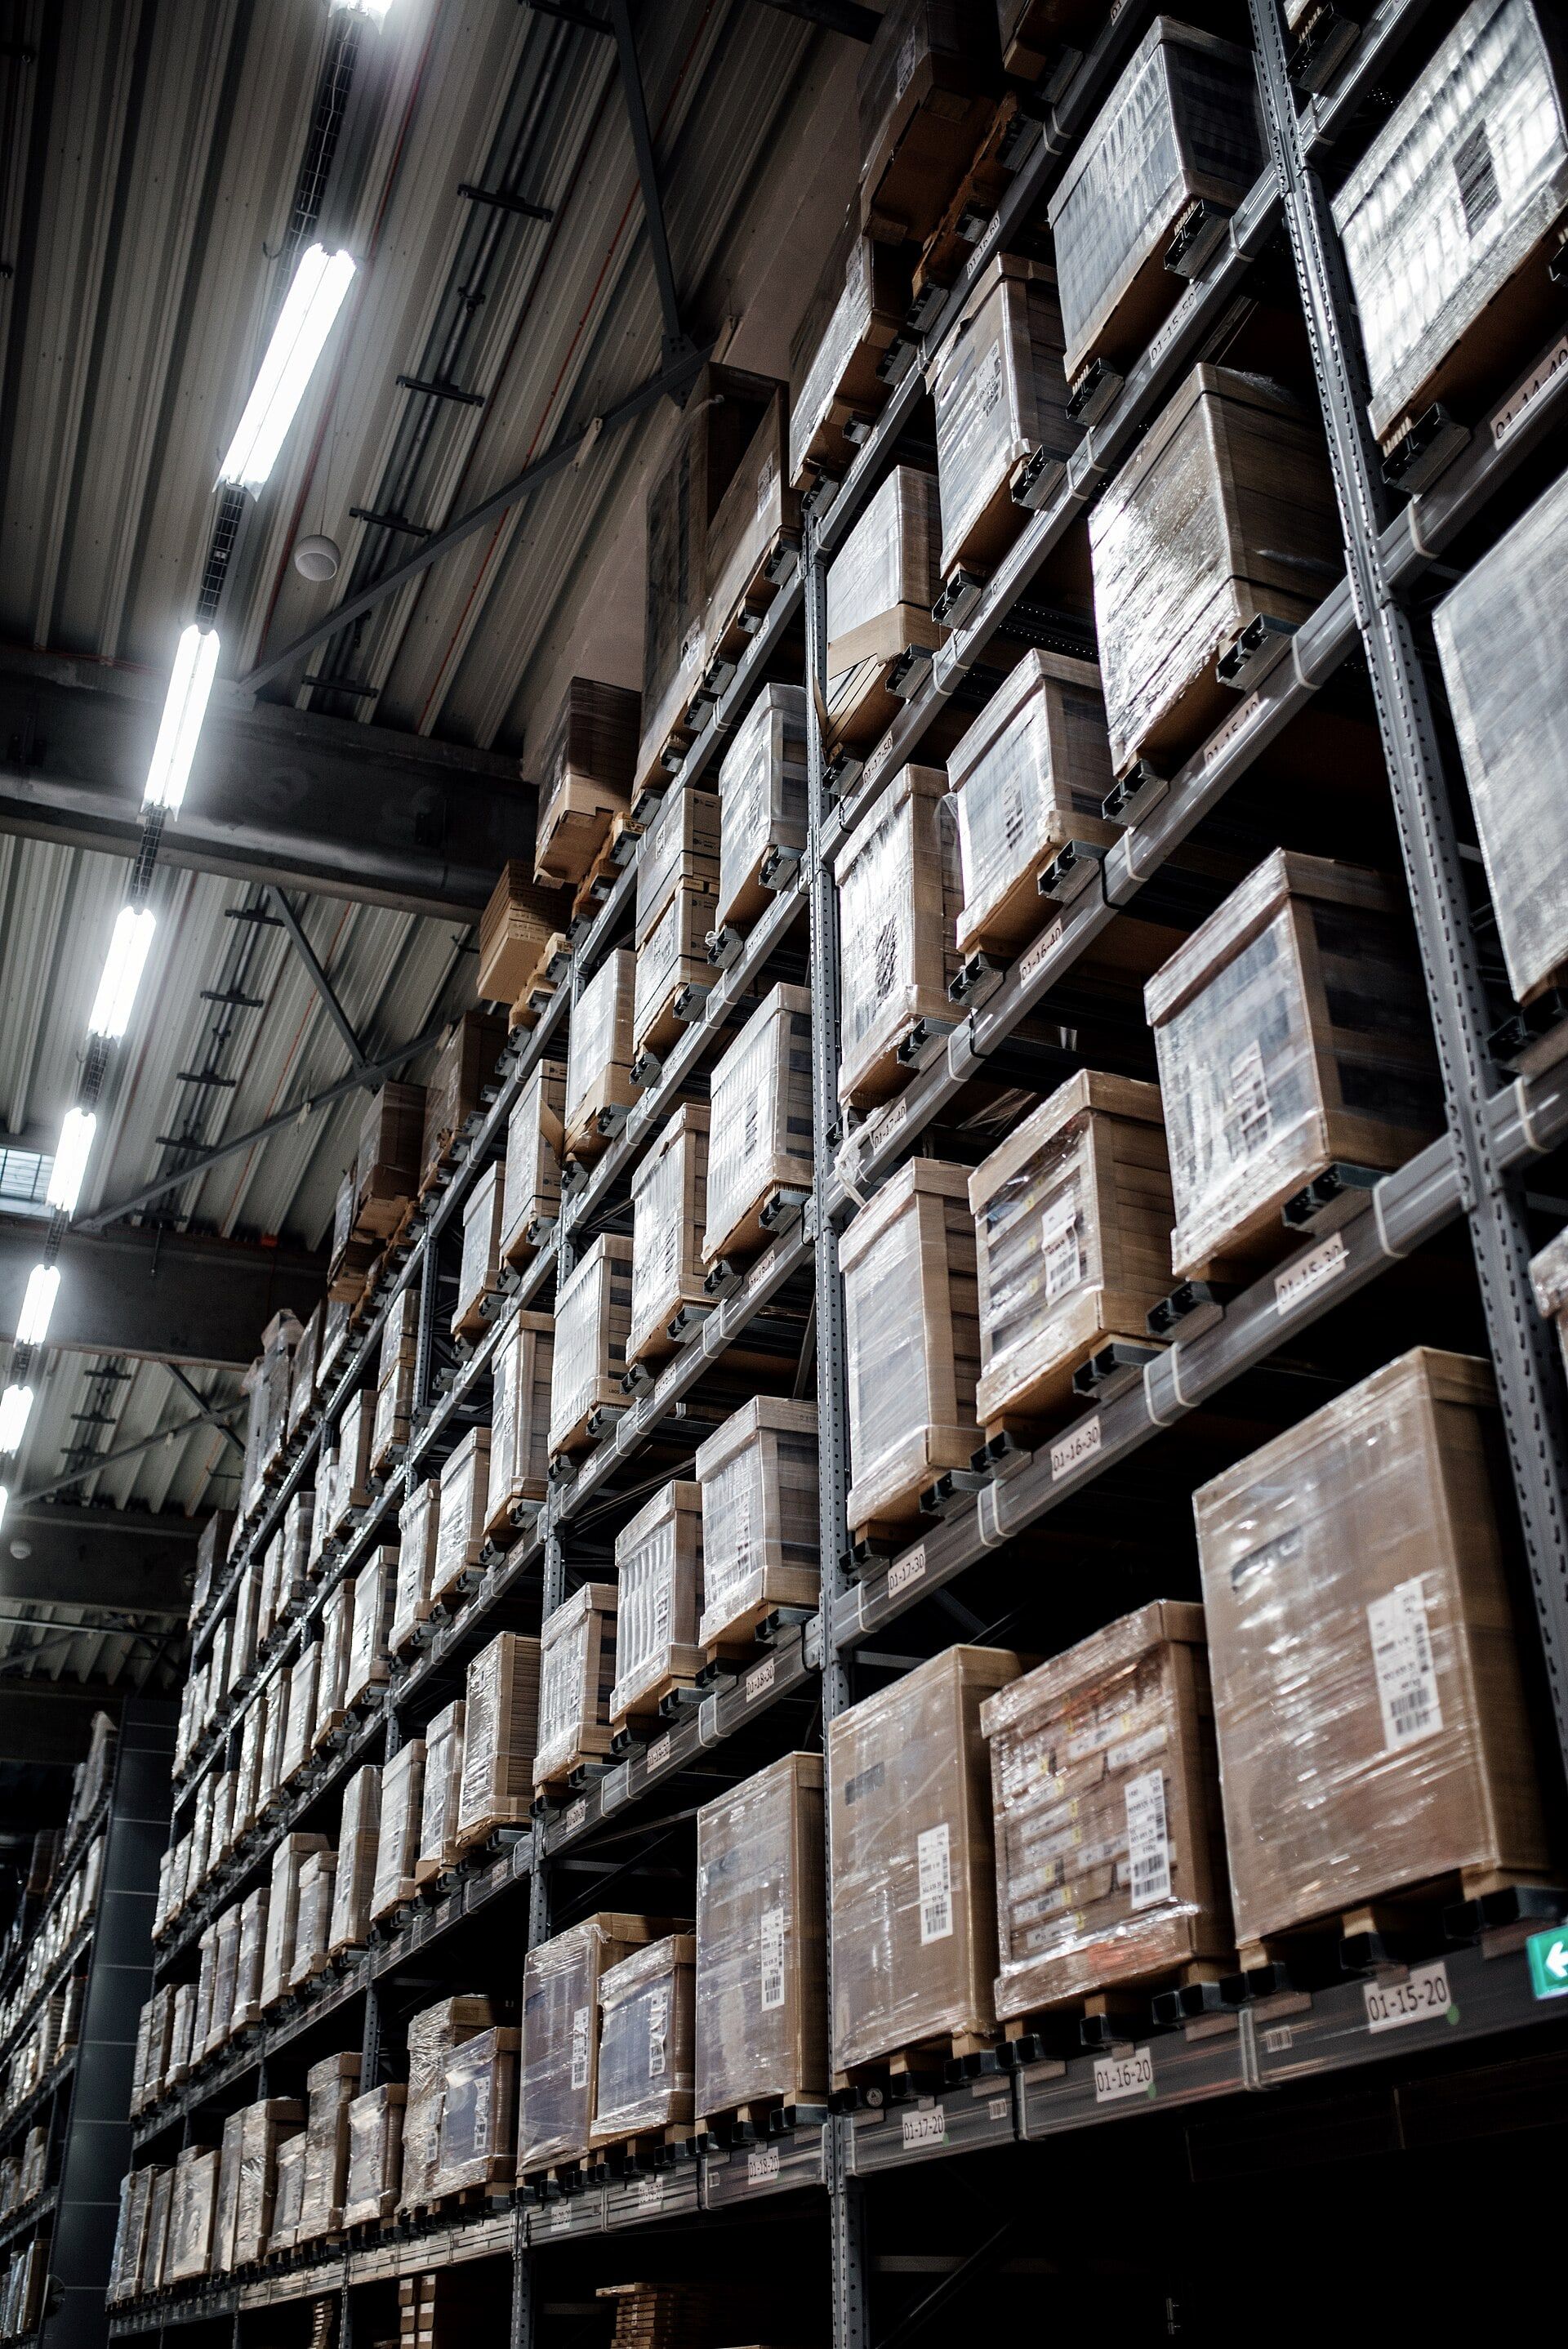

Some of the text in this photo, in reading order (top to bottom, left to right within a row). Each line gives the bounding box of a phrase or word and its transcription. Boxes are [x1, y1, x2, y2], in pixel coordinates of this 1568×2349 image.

[1151, 292, 1194, 360] 01-15-50
[1054, 1427, 1098, 1472] 01-16-30
[889, 1553, 924, 1590] 01-17-30
[747, 1665, 774, 1696] 01-18-30
[1368, 1977, 1446, 2021] 01-15-20
[1096, 2059, 1151, 2093] 01-16-20
[904, 2115, 943, 2141] 01-17-20
[749, 2155, 778, 2177] 01-18-20
